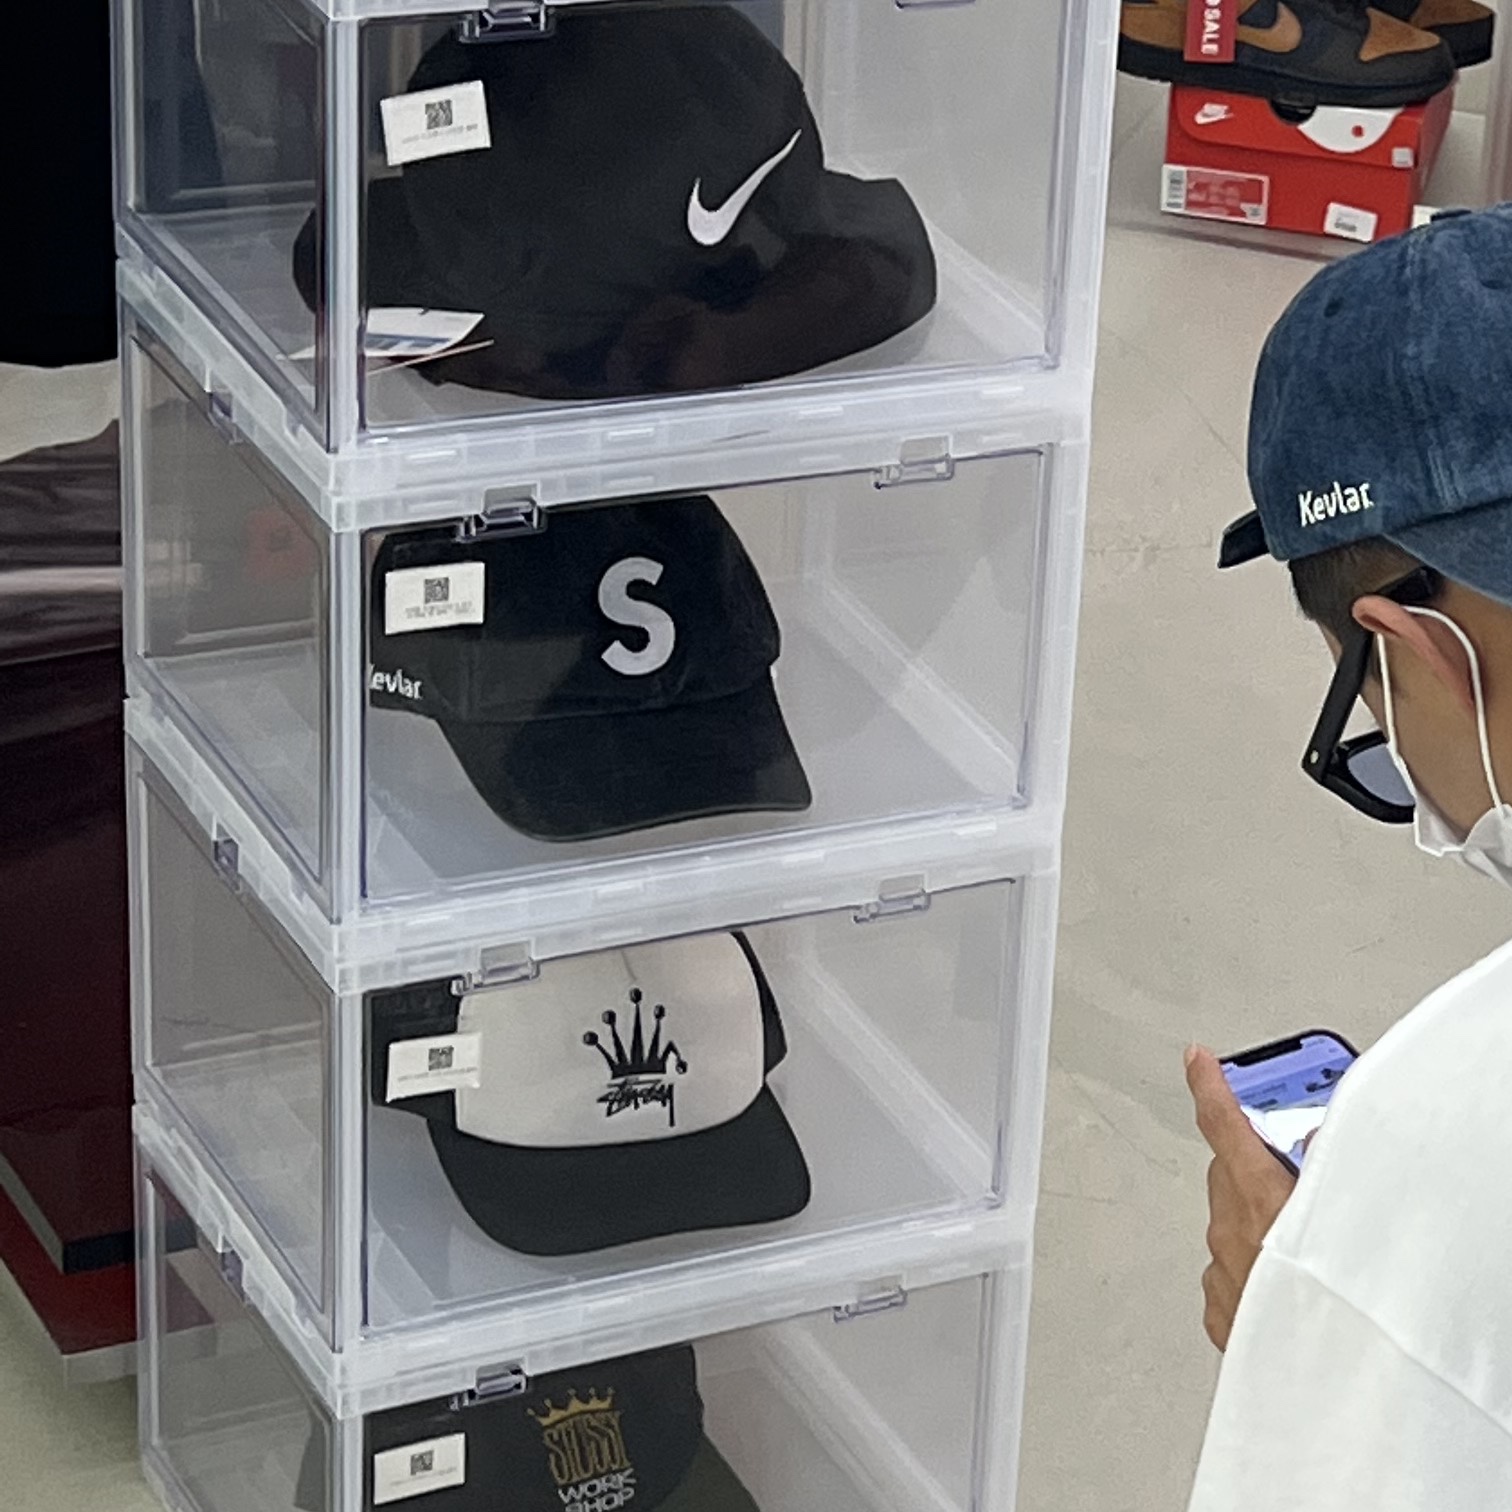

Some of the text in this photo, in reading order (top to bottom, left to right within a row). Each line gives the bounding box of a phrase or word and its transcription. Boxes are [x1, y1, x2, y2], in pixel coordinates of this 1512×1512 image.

[1201, 8, 1221, 55] SALE
[598, 556, 676, 675] S
[558, 1468, 637, 1504] WORK
